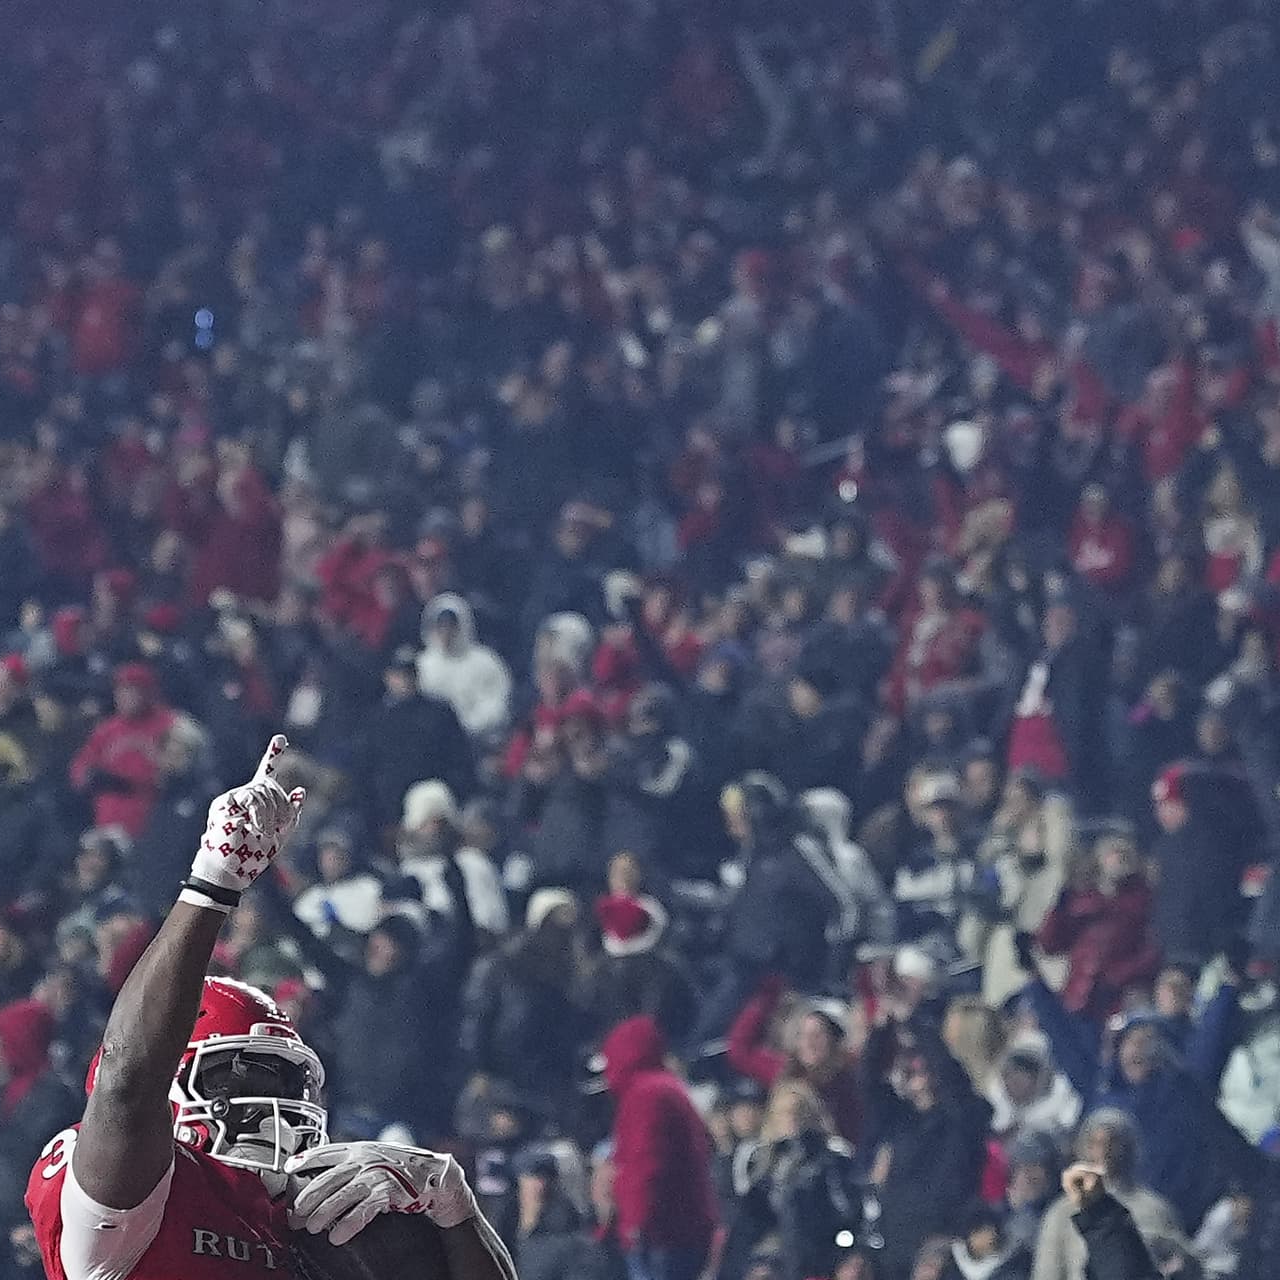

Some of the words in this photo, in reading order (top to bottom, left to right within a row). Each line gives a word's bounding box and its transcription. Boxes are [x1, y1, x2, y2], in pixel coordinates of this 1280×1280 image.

[219, 843, 235, 857] R
[235, 844, 253, 864] R
[40, 1128, 78, 1180] 3
